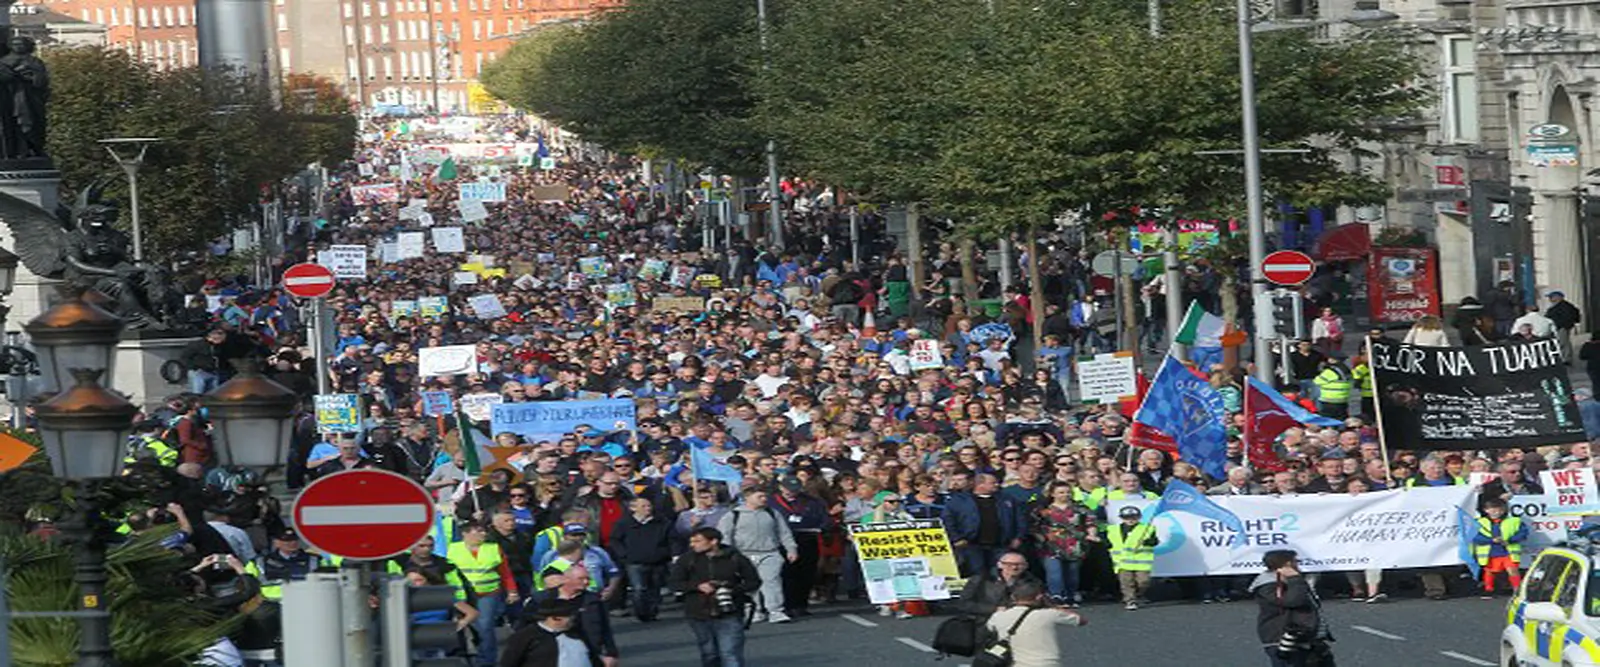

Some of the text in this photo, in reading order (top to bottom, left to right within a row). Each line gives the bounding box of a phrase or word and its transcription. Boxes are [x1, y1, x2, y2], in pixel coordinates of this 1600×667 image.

[1436, 351, 1476, 376] NA
[1551, 470, 1585, 486] WE
[1558, 494, 1585, 506] PAY
[1345, 509, 1449, 528] WATER IS A
[1532, 520, 1582, 531] TO W
[858, 532, 944, 545] Resist the
[1329, 528, 1400, 545] HUMAN
[861, 544, 949, 557] Water Tax
